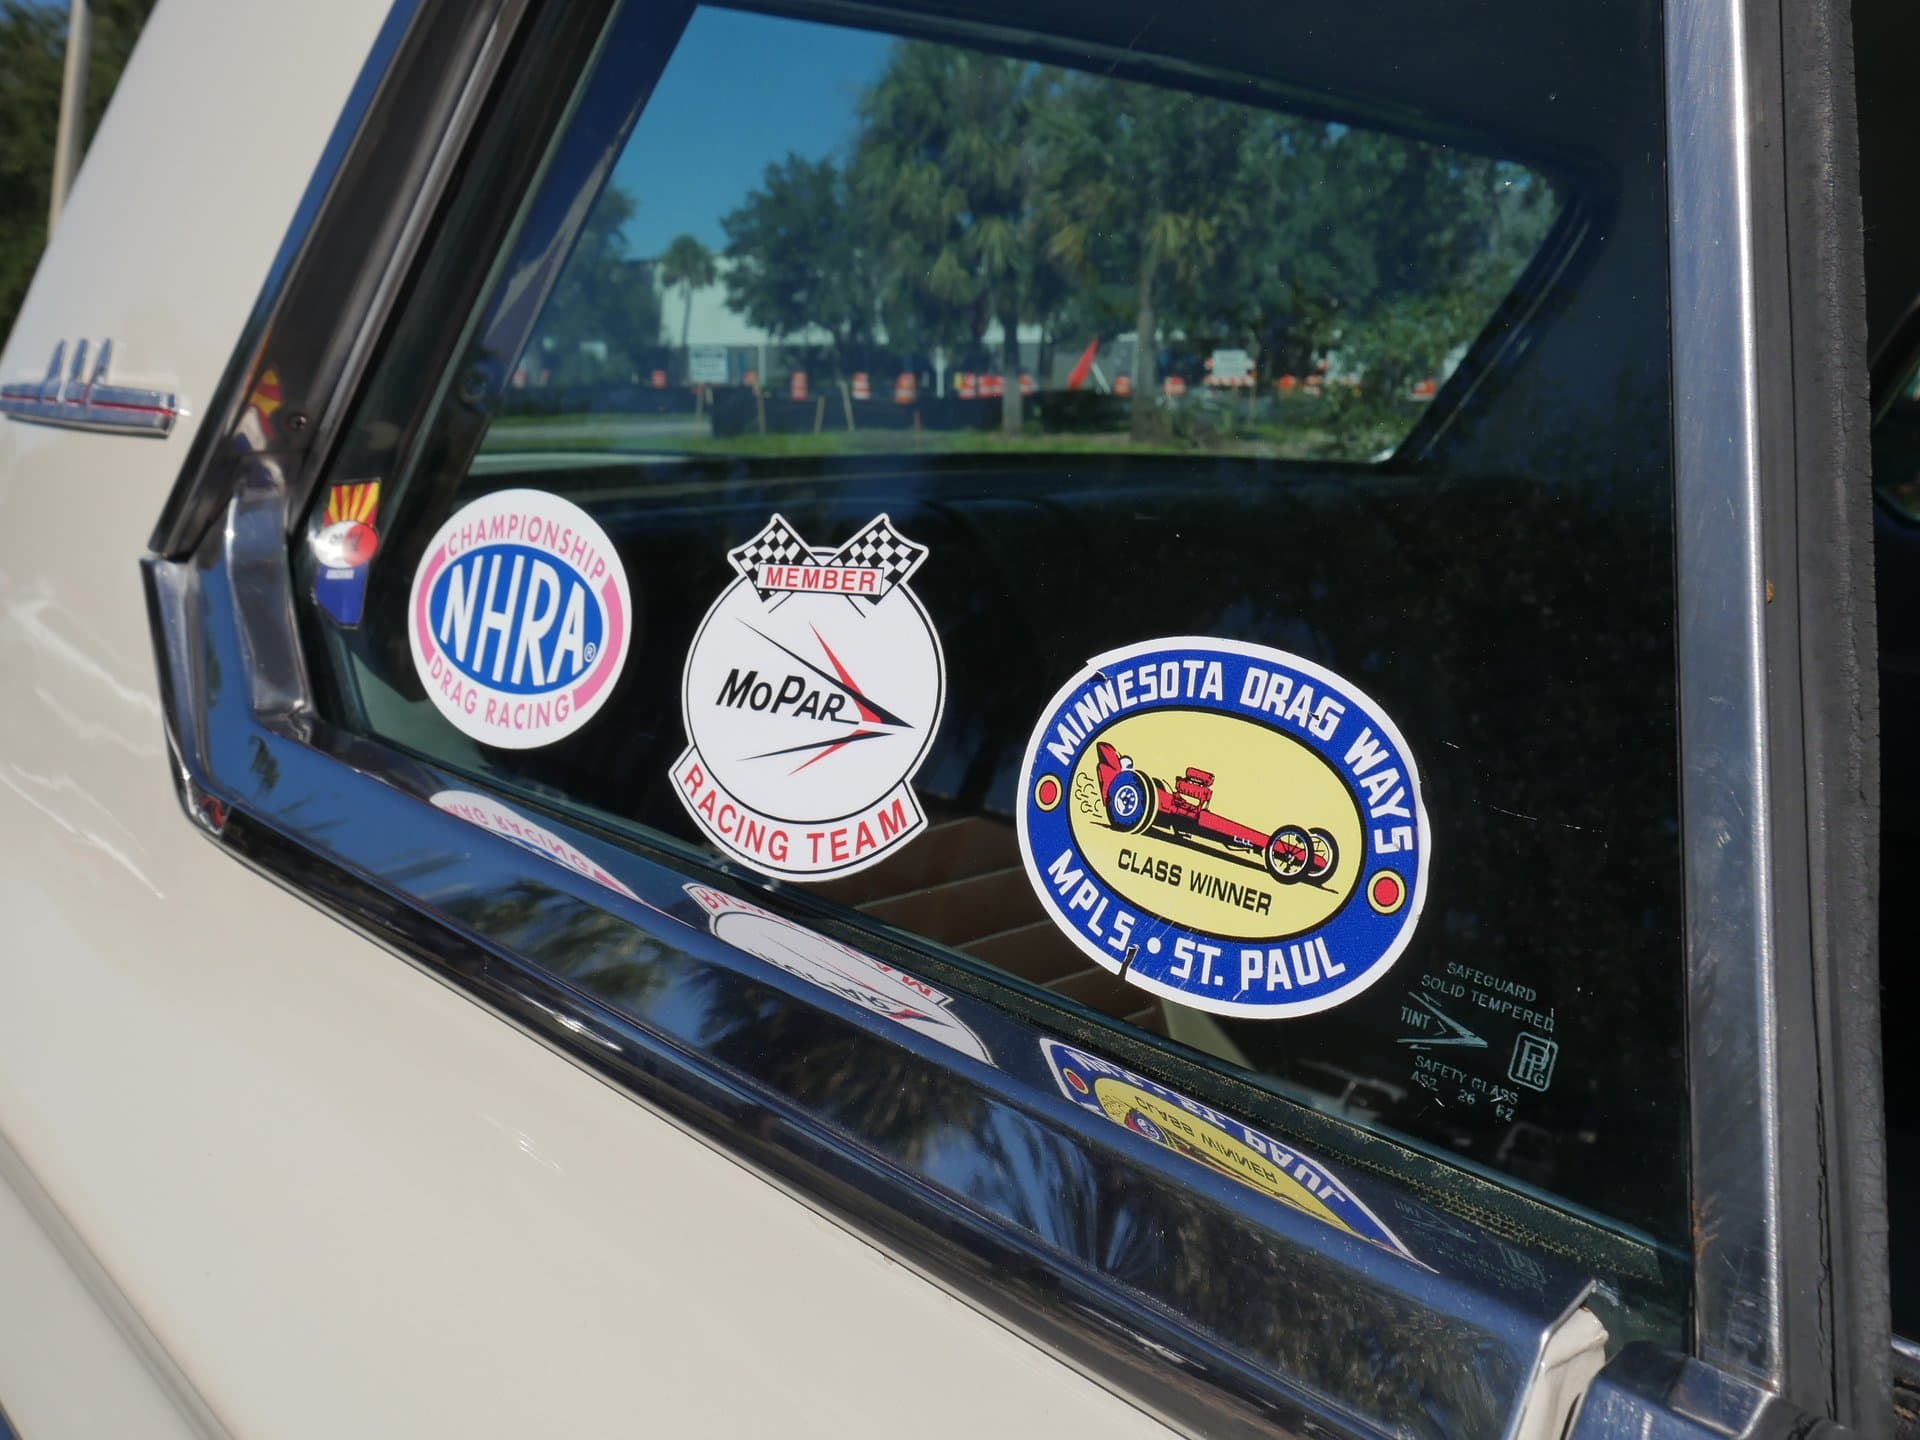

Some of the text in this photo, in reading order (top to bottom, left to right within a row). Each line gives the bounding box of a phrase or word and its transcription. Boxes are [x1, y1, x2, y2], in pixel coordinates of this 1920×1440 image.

[447, 513, 607, 581] CHAMPIONSHIP
[764, 566, 877, 593] MEMBER
[430, 654, 570, 730] DRAG RACING
[1046, 659, 1413, 855] MINNESOTA DRAG WAYS
[683, 763, 909, 865] RACING TEAM
[1117, 847, 1273, 916] CLASS WINNER
[1047, 848, 1347, 992] MPLS ST. PAUL
[1420, 973, 1555, 1033] SOLID TEMPERED
[1446, 961, 1537, 1002] SAFEGUARD
[1400, 1005, 1432, 1030] TINT
[1414, 1055, 1519, 1105] SAFETY GLASS
